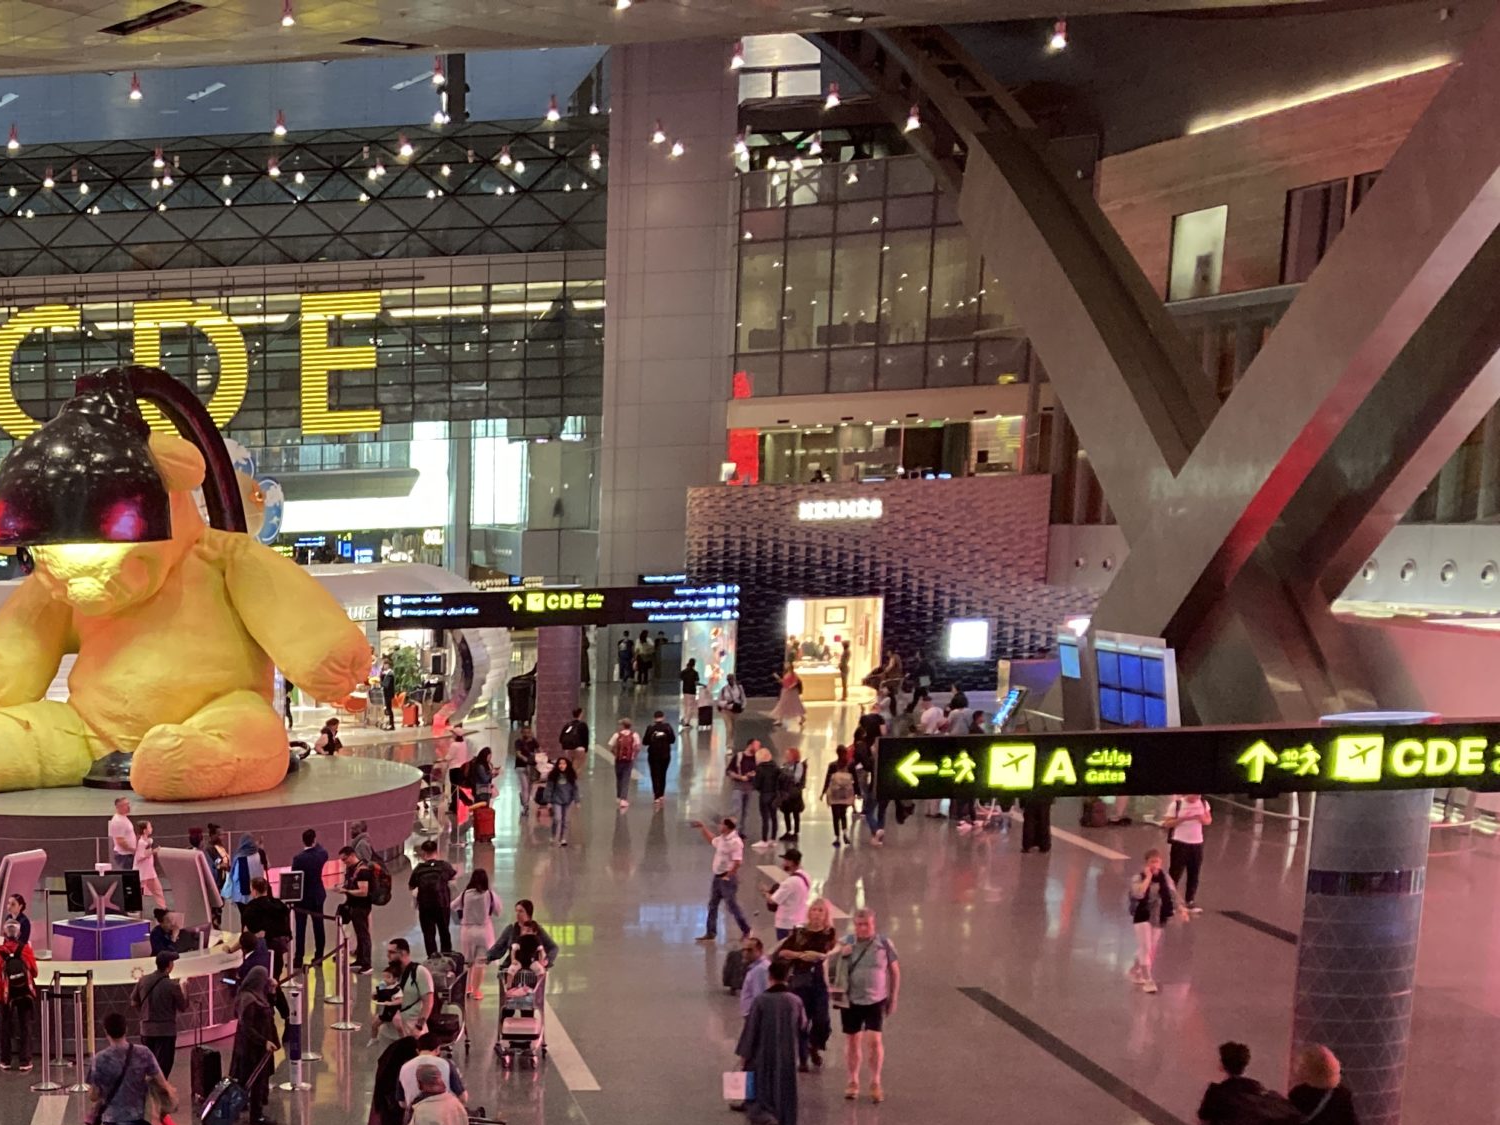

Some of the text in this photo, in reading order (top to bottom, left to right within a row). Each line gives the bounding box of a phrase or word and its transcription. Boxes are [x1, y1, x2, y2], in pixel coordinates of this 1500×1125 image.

[547, 593, 585, 609] CDE
[1042, 748, 1077, 784] A
[1086, 749, 1133, 767] بوابات
[1390, 737, 1488, 778] CDE
[1085, 769, 1126, 784] Gates
